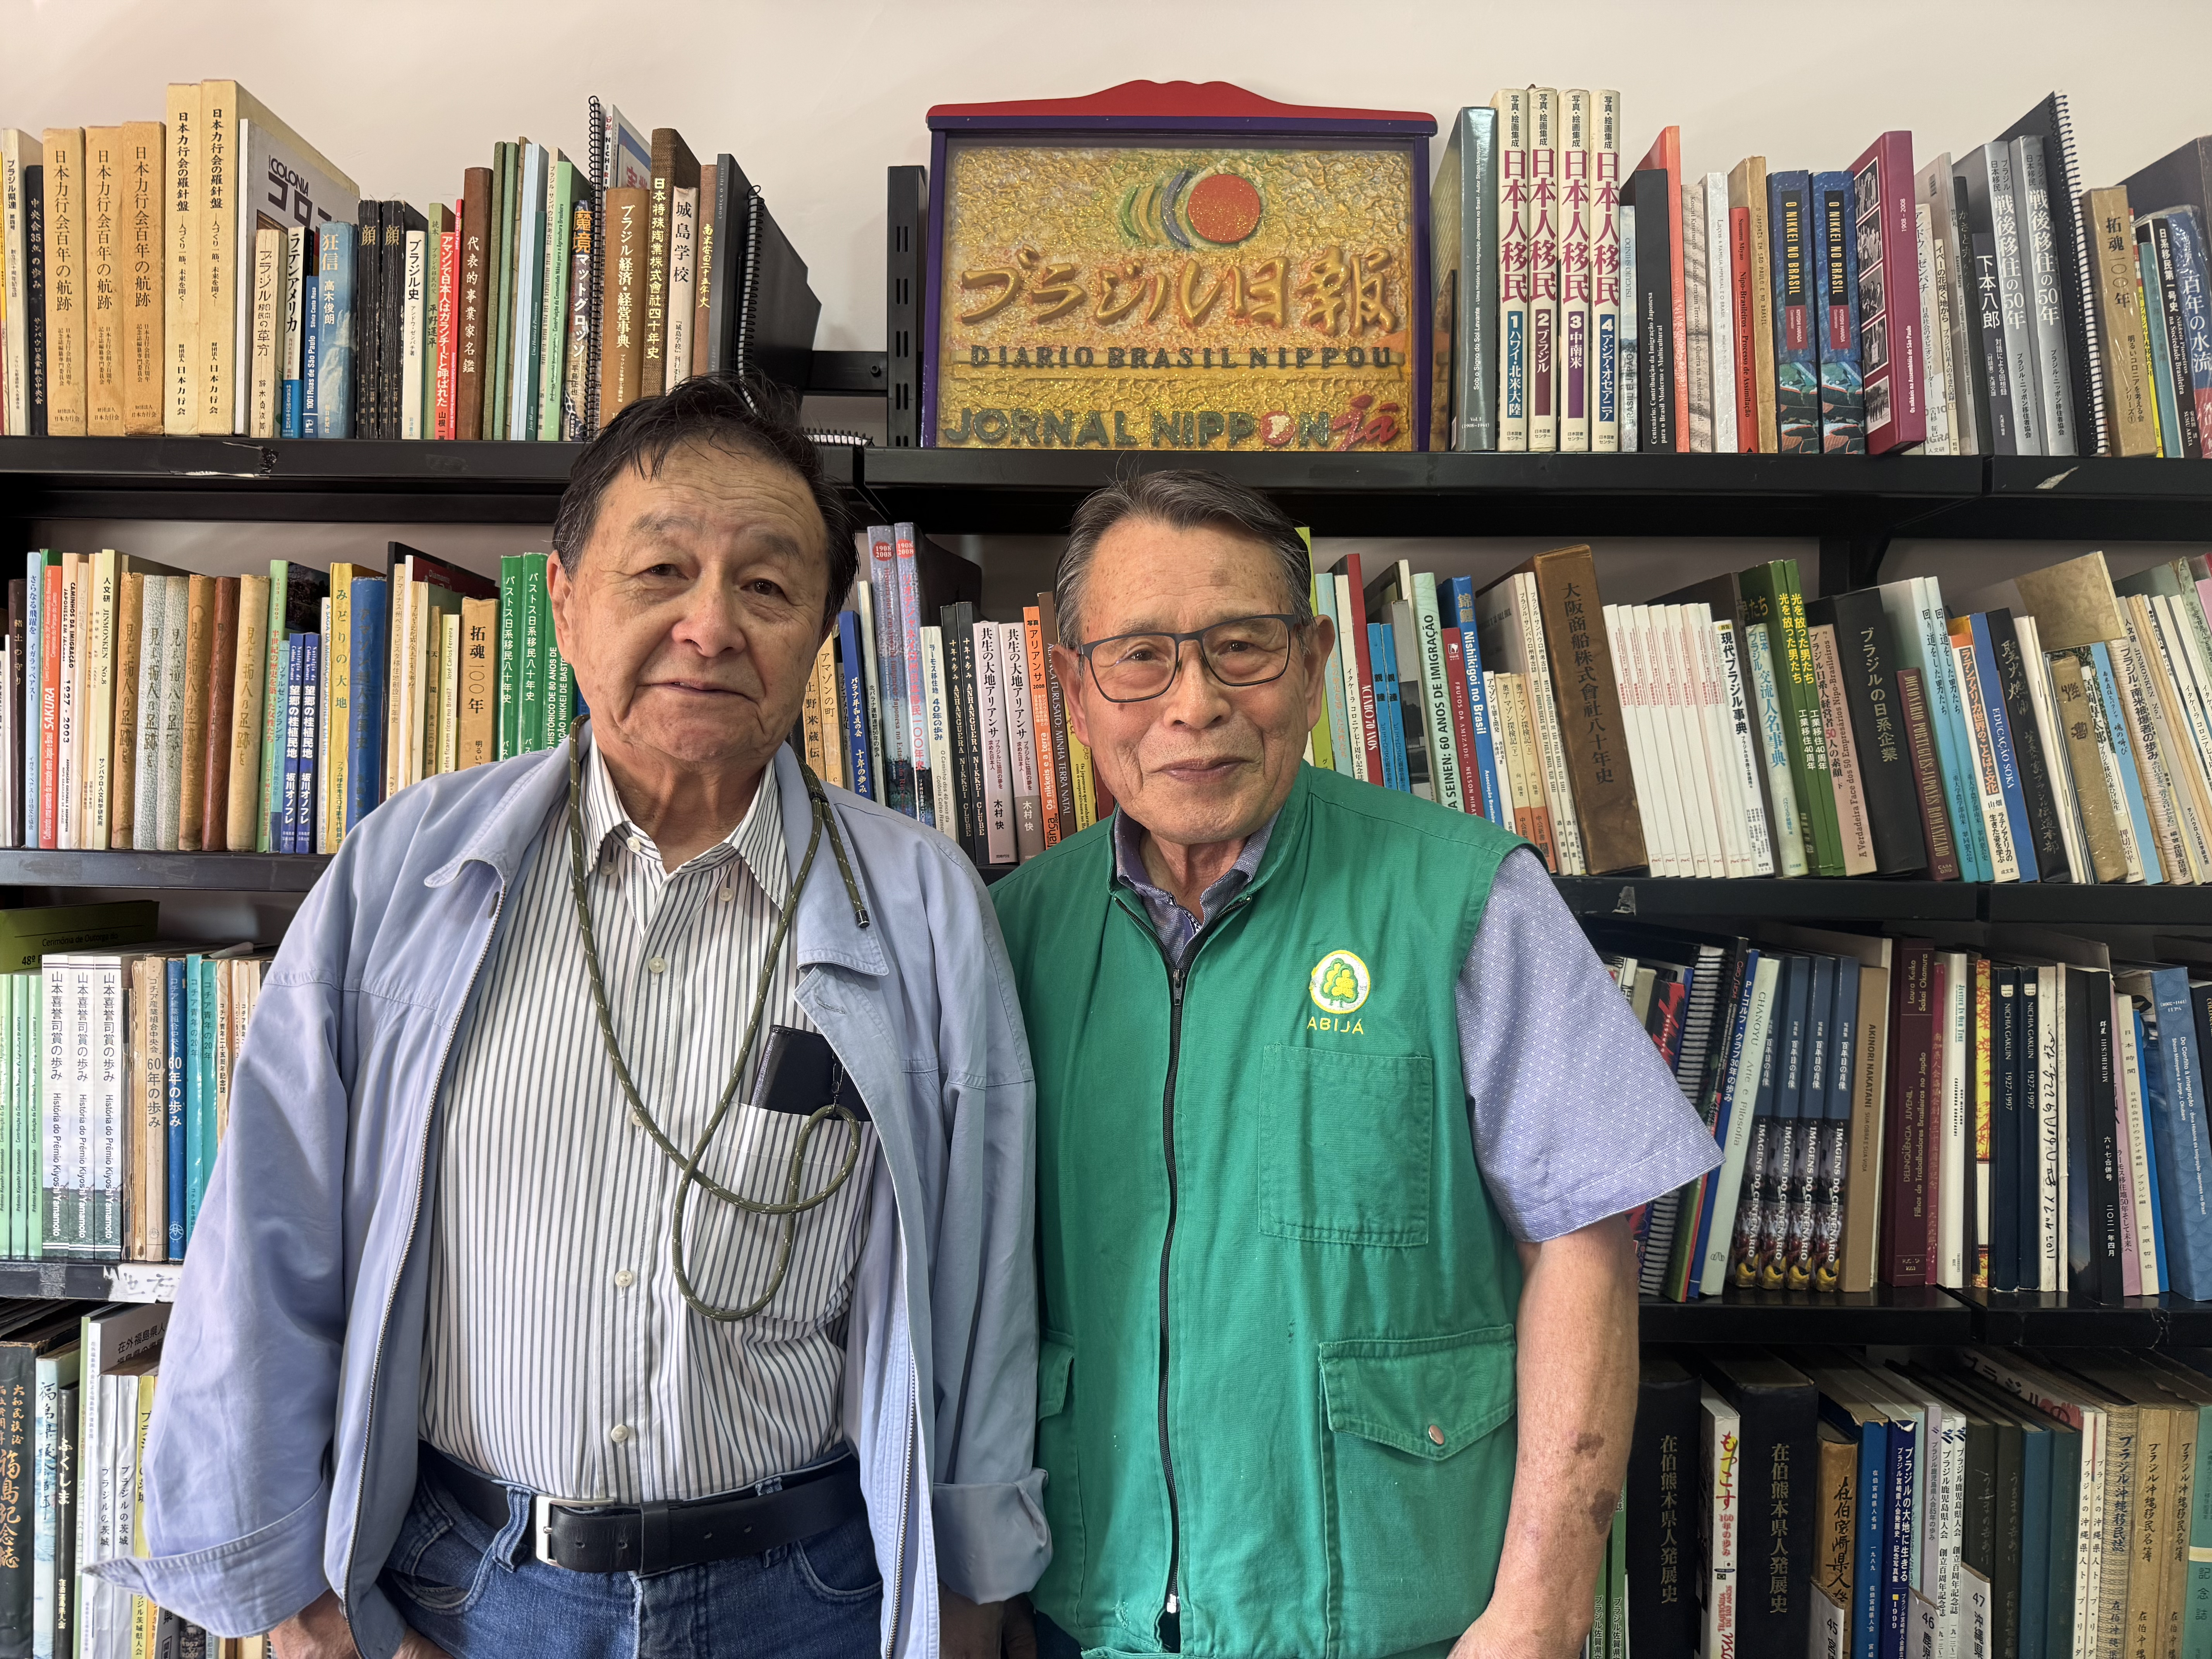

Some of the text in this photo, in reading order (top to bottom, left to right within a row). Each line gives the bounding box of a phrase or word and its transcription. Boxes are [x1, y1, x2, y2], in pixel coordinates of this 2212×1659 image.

[1511, 95, 1519, 148] 写真・絵画集成
[1539, 94, 1547, 146] 写真・絵画集成
[176, 112, 190, 212] 日本力行会の羅針盤
[210, 109, 223, 209] 日本力行会の羅針盤
[271, 158, 309, 196] COLONIA
[53, 150, 72, 311] 日本力行会百年の航跡
[96, 149, 113, 310] 日本力行会百年の航跡
[133, 146, 151, 308] 日本力行会百年の航跡
[322, 234, 338, 271] 狂信
[361, 225, 376, 246] 顔
[385, 225, 399, 246] 顔
[673, 201, 692, 283] 城島学校
[1501, 149, 1527, 304] 日本人移民
[1529, 148, 1556, 302] 日本人移民
[1562, 149, 1589, 304] 日本人移民
[1594, 152, 1619, 307] 日本人移民
[1786, 212, 1798, 242] NIKKEI
[1787, 246, 1799, 258] NO
[1994, 195, 2027, 330] 戦後移住の50年
[286, 233, 301, 333] ラテンアメリカ
[324, 280, 335, 325] 高木俊朗
[407, 240, 421, 301] ブラジル史
[463, 236, 479, 373] 代表的事業家名鑑
[573, 255, 590, 358] マットグロッソ
[616, 206, 635, 349] ブラジル経済・経営事典
[960, 244, 1394, 337] ブラジル日報
[1788, 263, 1800, 295] BRASIL
[1976, 254, 2001, 329] 下本八郎
[436, 236, 453, 408] アマゾンで日本人はガランチードと呼ばれた
[970, 345, 1390, 369] DIARIO BRASIL NIPPOU
[1537, 313, 1549, 373] 2 ブラジル
[1570, 316, 1582, 369] 3 中南米
[177, 366, 186, 415] 日本力行会
[1509, 316, 1521, 416] 1 ハワイ・北米大陸
[1601, 319, 1613, 421] 4 アジア・オセアニア
[944, 407, 1136, 446] JORNAL
[1151, 410, 1330, 446] NIPPON
[336, 589, 347, 709] みどりの大地
[503, 577, 515, 703] バストス日系移民八十年史
[550, 647, 557, 657] DE
[1029, 630, 1042, 682] アリアンサ
[1778, 593, 1802, 684] 光を放った男たち
[1791, 593, 1814, 684] 光を放った男たち
[1922, 609, 1948, 715] 回り道をした男たち
[45, 688, 54, 730] SAKURA
[550, 682, 556, 690] 80
[550, 692, 556, 702] DE
[821, 653, 835, 716] アマゾンの町
[932, 697, 943, 740] 40年の歩み
[953, 685, 964, 753] ANHANGUERA
[981, 628, 999, 738] 共生の大地アリアンサ
[1007, 629, 1027, 740] 共生の大地アリアンサ
[1422, 615, 1456, 792] SEINEN: 60 ANOS DE IMIGRAÇÃO
[1464, 631, 1486, 734] Nishikigoi no Brasil
[1561, 582, 1614, 785] 大阪商船株式會社八十年史
[1720, 633, 1747, 734] 現代ブラジル事典
[1759, 672, 1786, 768] 交流人名事典
[1860, 627, 1897, 762] ブラジルの日系企業
[2120, 647, 2159, 761] ブラジル・南米被爆者の歩み
[287, 685, 301, 758] 望郷の桂植民地
[546, 704, 556, 744] HISTÓRICO
[1051, 682, 1060, 727] FURUSATO:
[1061, 790, 1070, 816] NATAL
[1799, 709, 1815, 771] 工業移住40周年
[1961, 649, 1998, 794] ラテンアメリカ世界のことばと文化
[1992, 708, 2014, 788] EDUCAÇÃO SOKA
[284, 773, 296, 824] 坂川オノフレ
[855, 749, 867, 793] 十年の歩み
[1043, 769, 1051, 797] nikkeis
[1046, 799, 1053, 810] Os
[1997, 812, 2013, 862] ラテンアメリカの
[1307, 1016, 1364, 1035] ABIJA
[1724, 980, 1752, 1102] PLゴルフ・クラブ30年の歩み
[1750, 991, 1766, 1046] CHANOYU
[2125, 1030, 2136, 1075] 日本時間
[147, 1058, 161, 1128] 60年の歩み
[1745, 1060, 1754, 1083] Arte
[1788, 1040, 1798, 1089] 百年目の肖像
[1865, 1024, 1875, 1108] AKINORI NAKATANI
[53, 1124, 61, 1133] do
[1733, 1101, 1747, 1147] Filosofia
[52, 1165, 61, 1193] Kiyoshi
[2106, 1204, 2115, 1257] 二〇二一年四月
[58, 1438, 73, 1505] ふくしま
[100, 1468, 111, 1547] ブラジルの茨城
[1716, 1431, 1738, 1510] もっこす
[1940, 1451, 1951, 1539] ブラジル鹿児島県人会
[2112, 1436, 2134, 1553] ブラジル沖縄移民誌
[1660, 1436, 1678, 1603] 在伯熊本県人発展史
[1770, 1443, 1789, 1613] 在伯熊本県人発展史
[1900, 1447, 1914, 1582] ブラジルの大地に生きる
[1950, 1546, 1959, 1614] 創立百周年記念誌
[1973, 1592, 1985, 1607] 47
